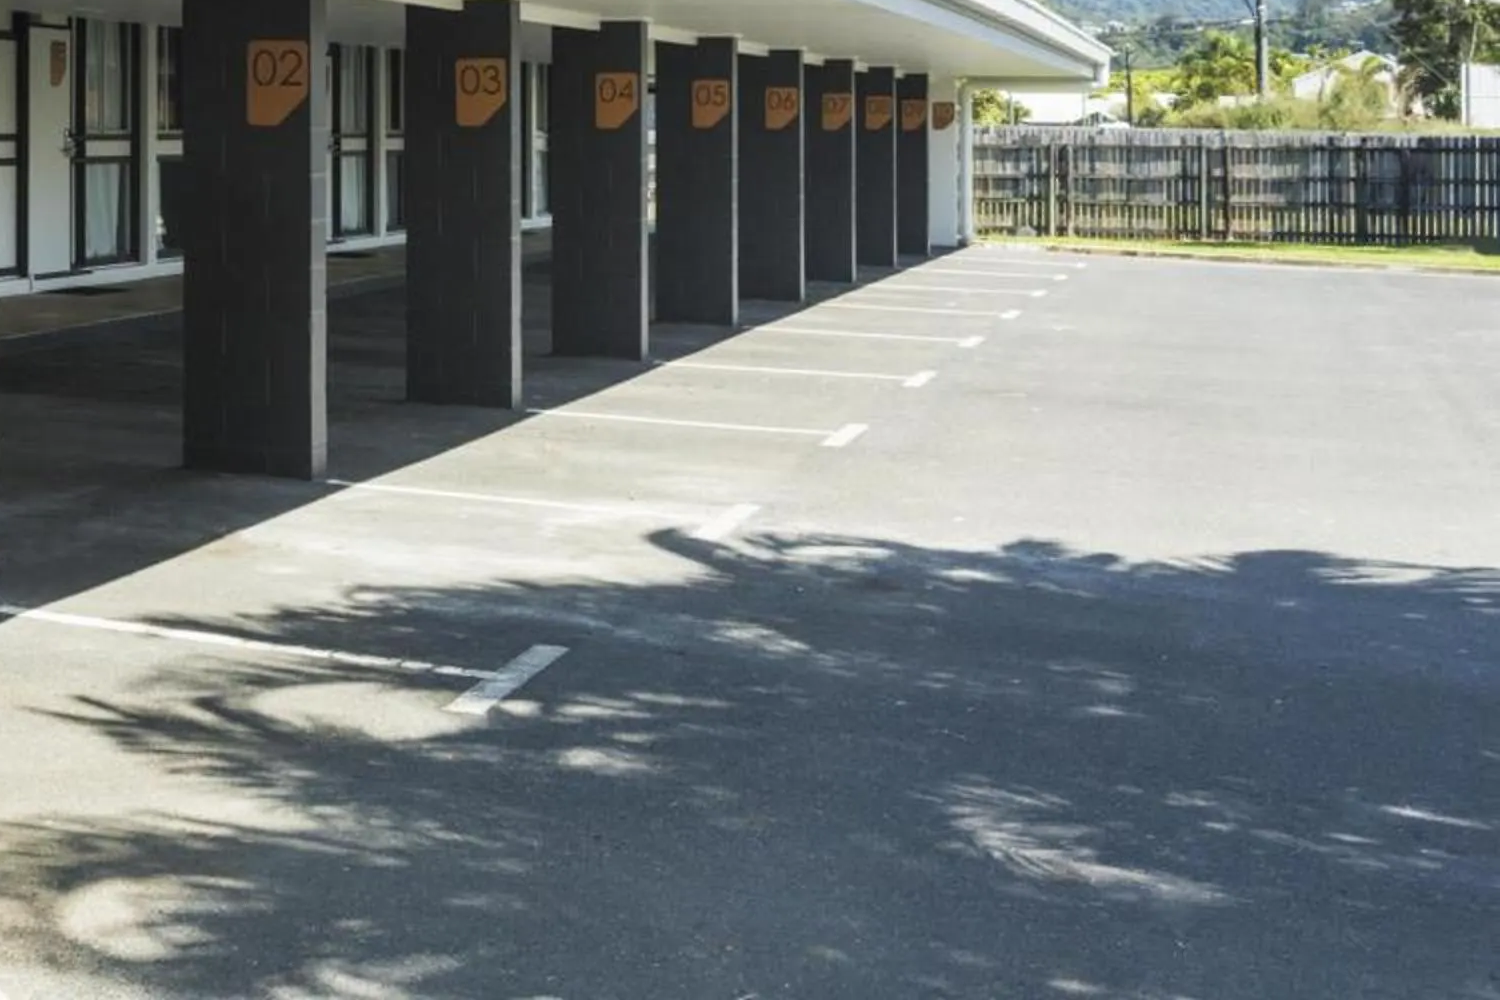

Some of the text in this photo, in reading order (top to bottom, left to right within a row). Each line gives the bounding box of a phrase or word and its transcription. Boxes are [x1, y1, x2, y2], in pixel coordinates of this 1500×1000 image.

[253, 49, 303, 87] 02
[461, 65, 501, 95] 03
[600, 79, 633, 102] 04
[697, 84, 727, 106] 05
[768, 90, 796, 111] 06
